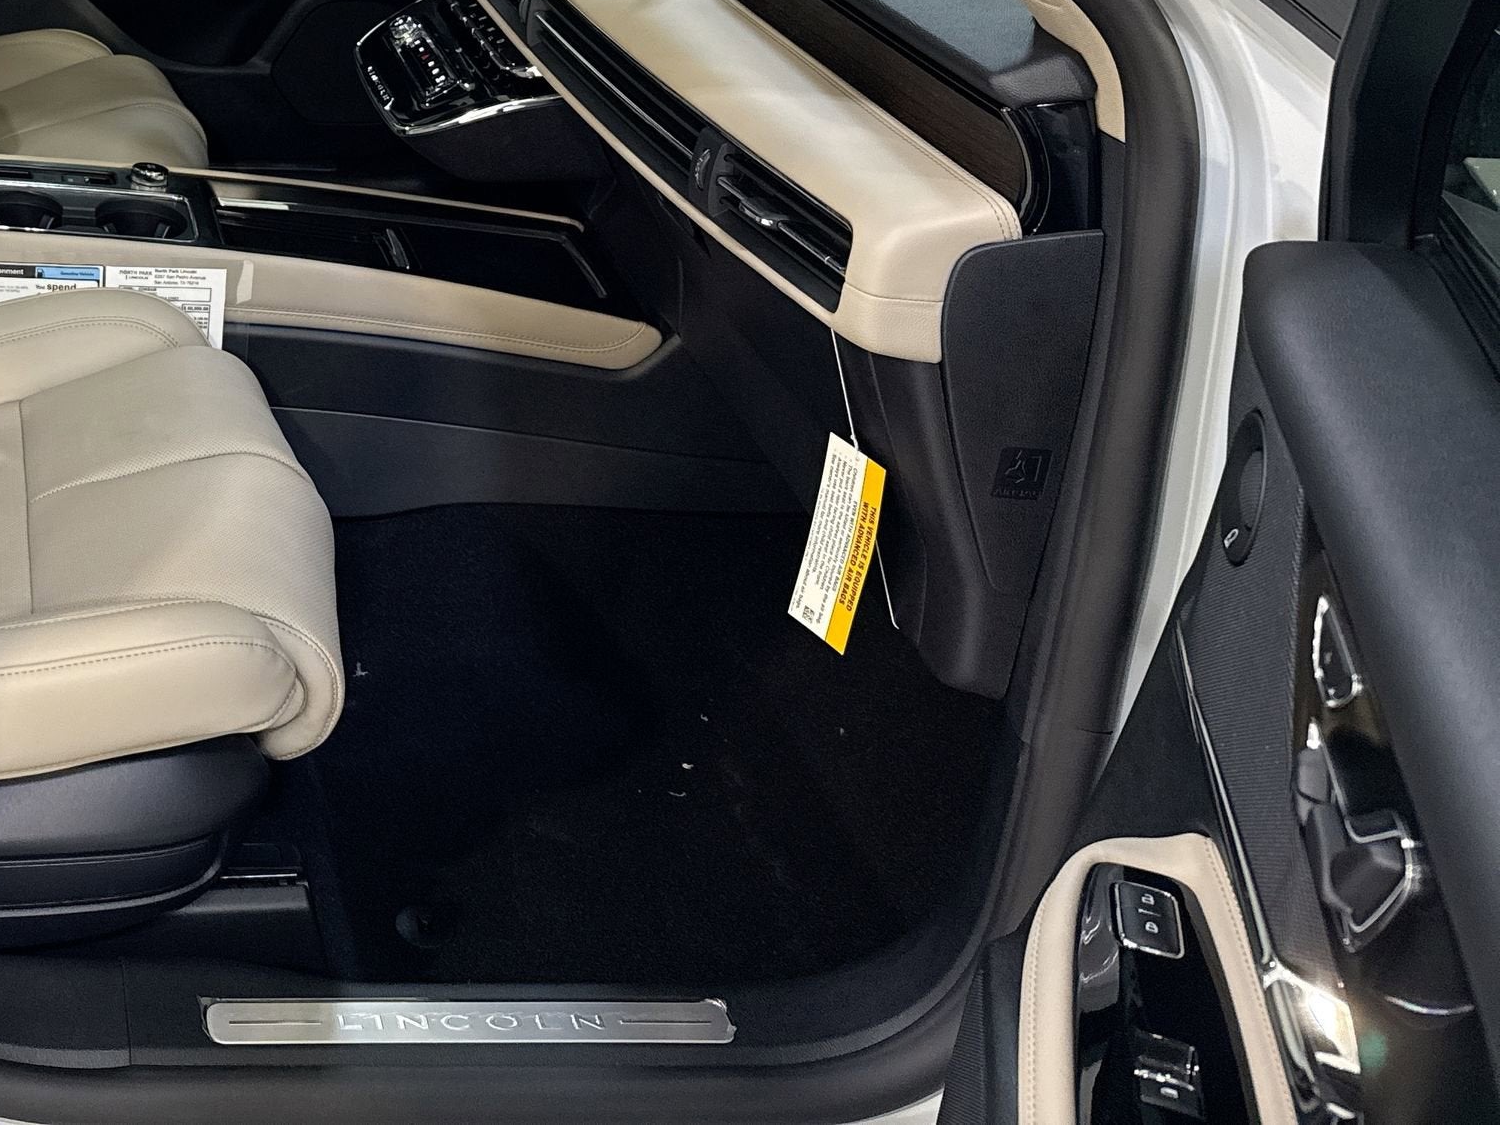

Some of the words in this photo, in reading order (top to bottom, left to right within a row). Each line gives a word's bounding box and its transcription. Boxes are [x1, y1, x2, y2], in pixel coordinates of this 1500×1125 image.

[860, 500, 869, 523] WITH
[868, 505, 876, 525] THIS
[839, 532, 850, 564] ADVANCED
[850, 522, 864, 567] ADVANCED
[860, 525, 872, 560] VEHICLE
[845, 566, 853, 582] AIR
[858, 560, 864, 570] IS
[838, 582, 849, 605] BAGS
[845, 569, 861, 612] EQUIPPED
[337, 1013, 605, 1031] LINCOLN
